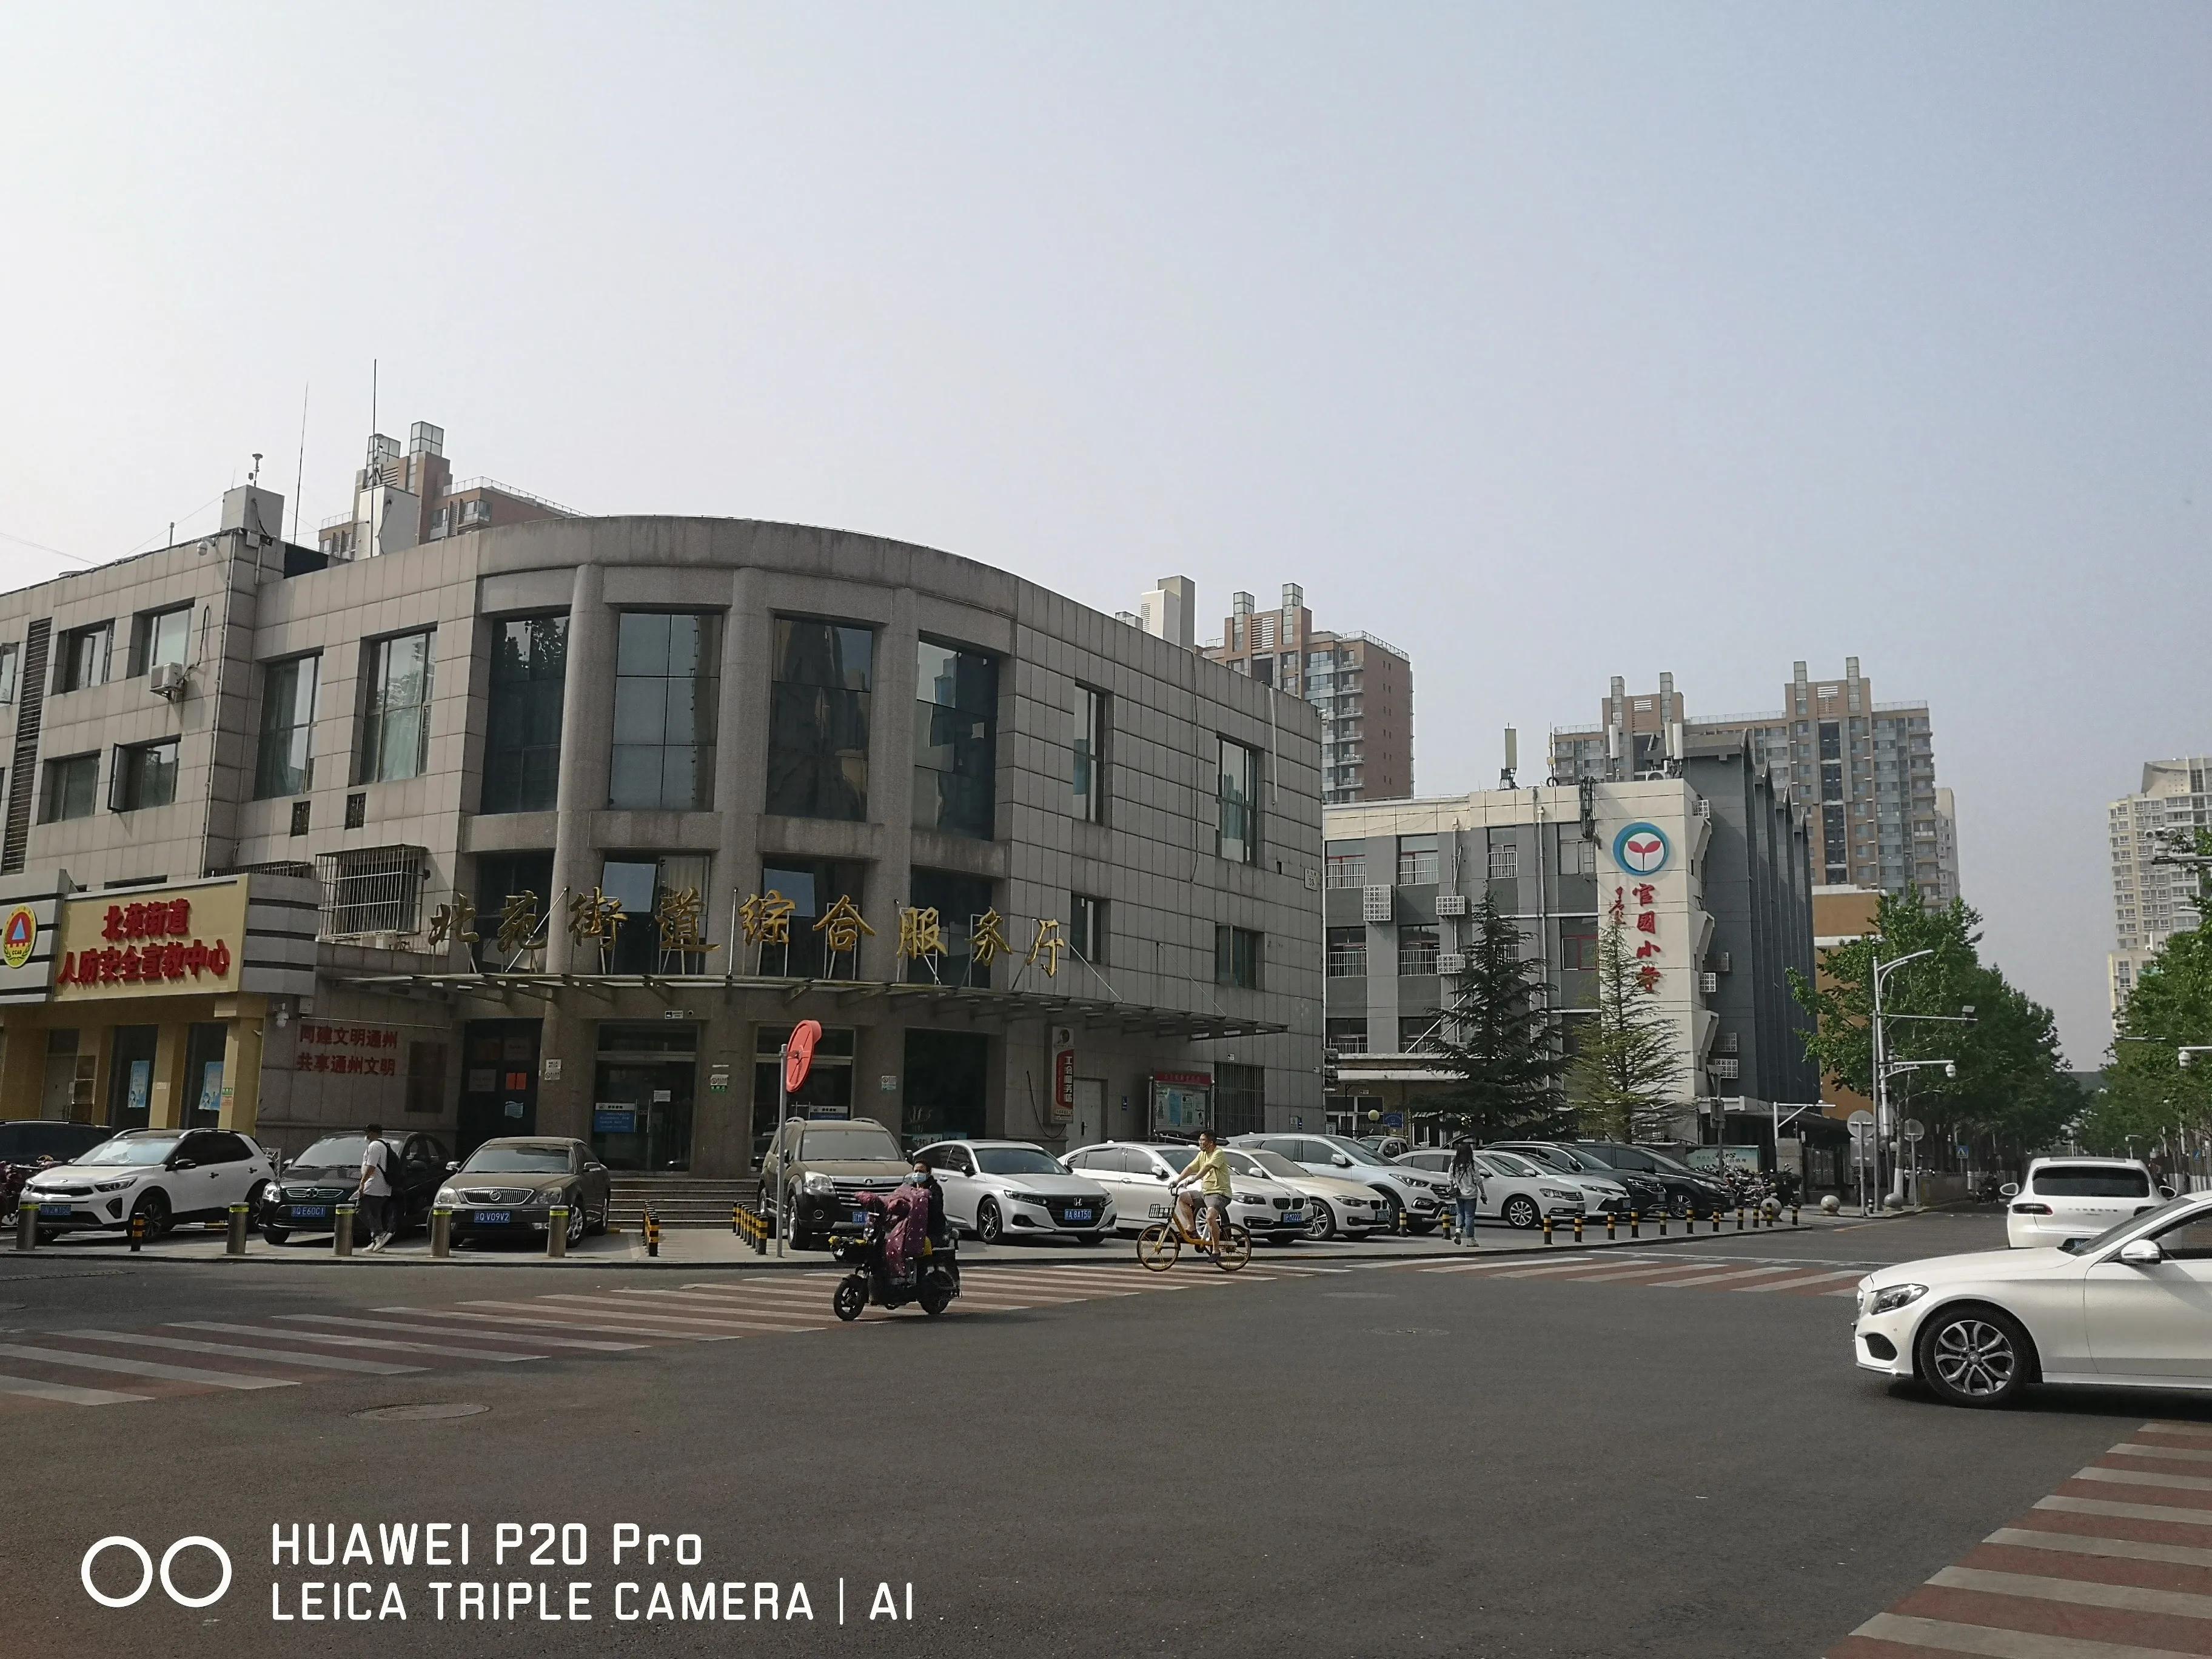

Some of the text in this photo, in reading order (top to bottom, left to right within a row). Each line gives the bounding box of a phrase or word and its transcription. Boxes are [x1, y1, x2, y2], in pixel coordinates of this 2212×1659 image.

[101, 898, 190, 941] 北苑街道
[428, 886, 1065, 978] 北苑街道综合服务厅
[58, 939, 230, 984] 人防安全宣教中心
[296, 1052, 395, 1077] 共享通州文明
